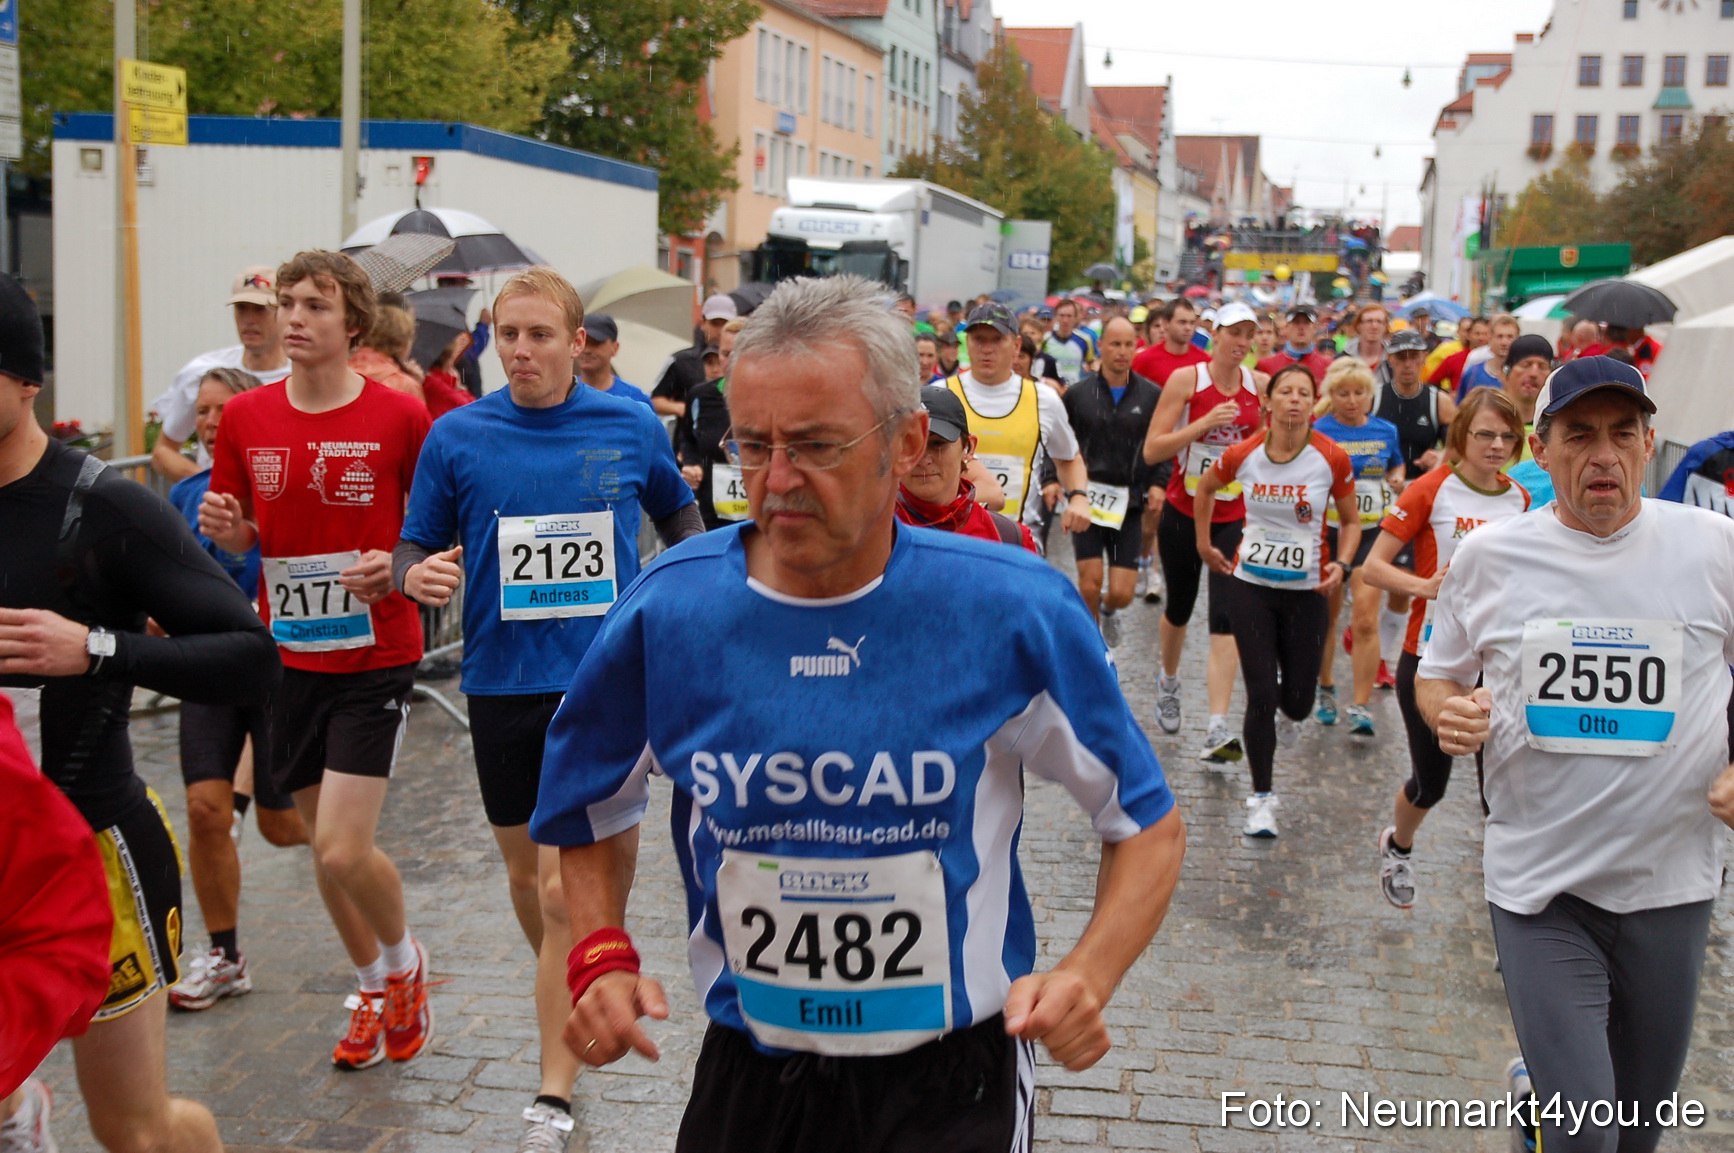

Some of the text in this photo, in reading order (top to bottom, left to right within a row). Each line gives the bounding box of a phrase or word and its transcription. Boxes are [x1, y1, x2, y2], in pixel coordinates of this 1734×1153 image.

[306, 442, 380, 451] 11. NEUMARKTER
[318, 449, 369, 458] STADTLAUF
[254, 472, 280, 484] NEU
[1253, 484, 1308, 497] MERZ
[535, 520, 581, 532] BOCK
[512, 540, 604, 580] 2123
[1247, 542, 1304, 569] 2749
[275, 580, 352, 617] 2177
[529, 589, 589, 604] Andreas
[290, 623, 348, 639] Christian
[1572, 626, 1634, 640] BOCK
[790, 655, 850, 677] PUMA
[1538, 652, 1666, 705] 2550
[1579, 713, 1619, 735] Otto
[690, 751, 956, 808] SYSCAD
[780, 870, 870, 893] BOCK
[741, 906, 924, 982] 2482
[800, 996, 863, 1027] Emil
